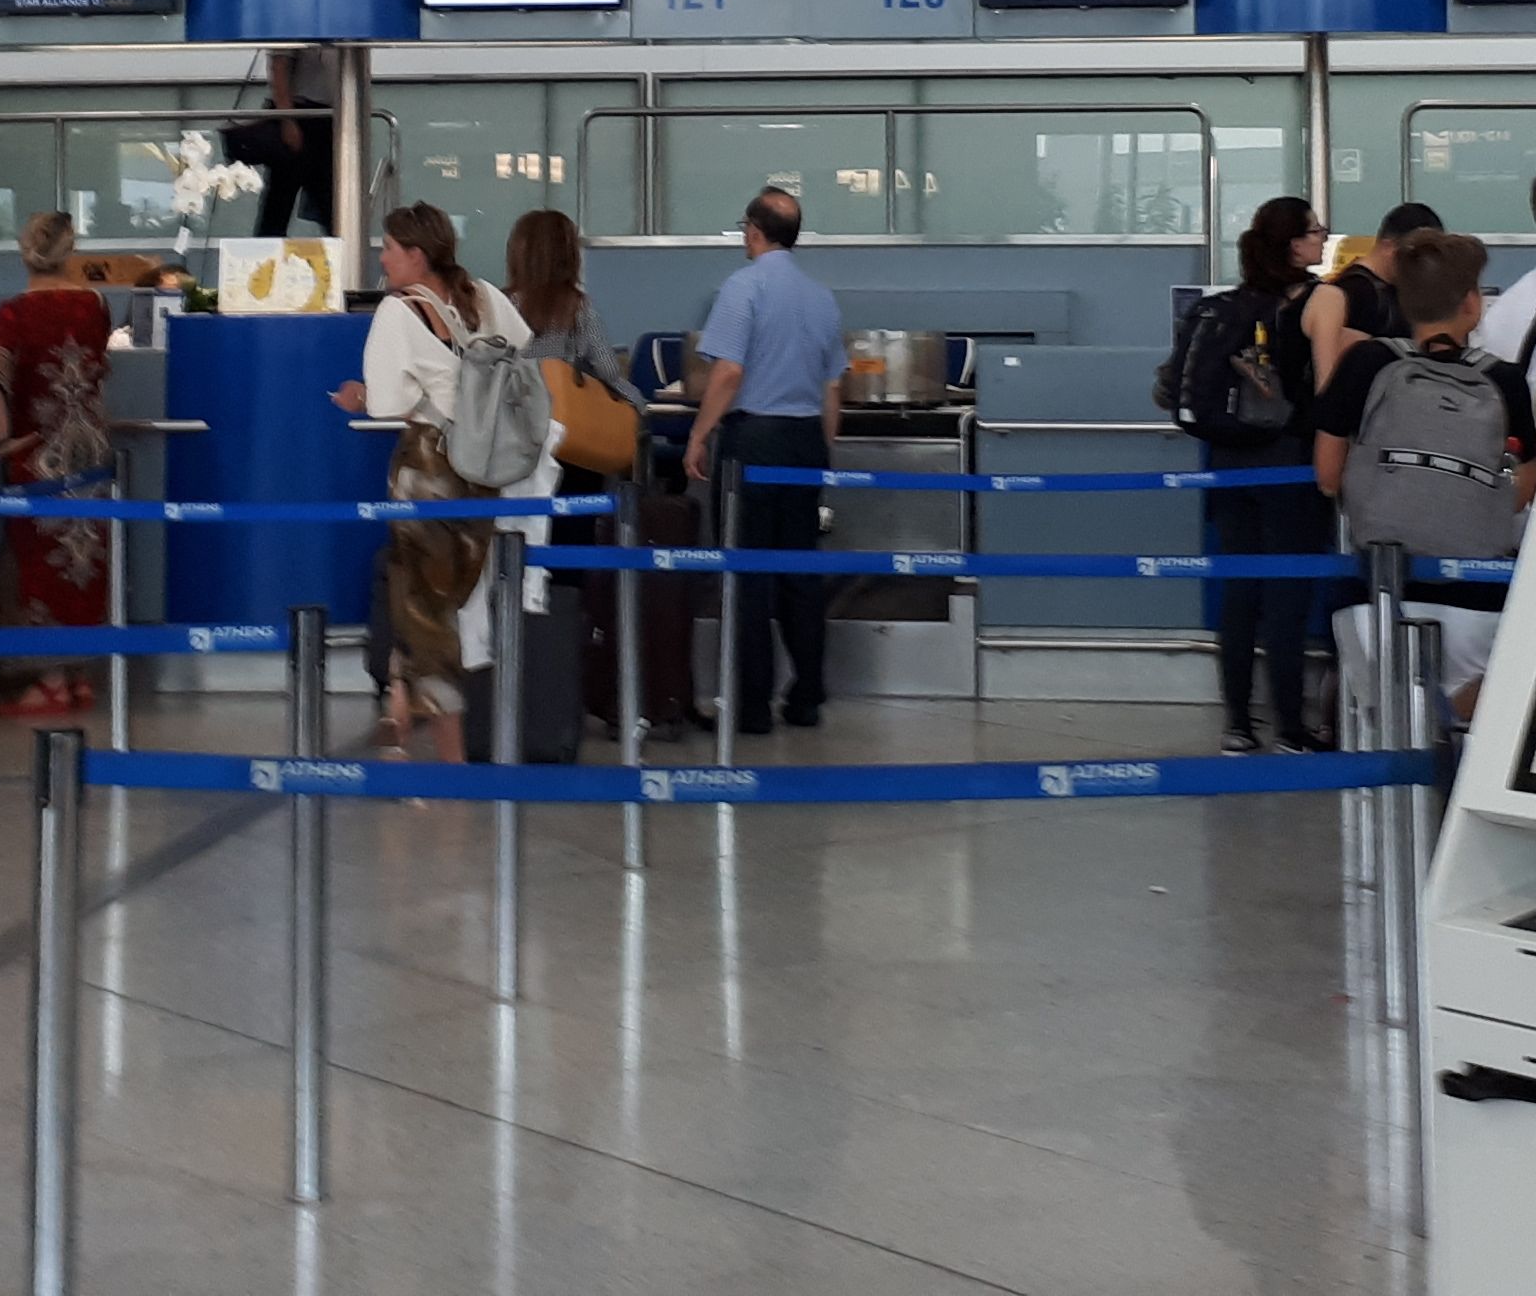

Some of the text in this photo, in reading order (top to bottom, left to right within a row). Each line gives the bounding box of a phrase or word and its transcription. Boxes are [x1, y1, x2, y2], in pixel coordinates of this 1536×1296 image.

[835, 472, 873, 482] ATHENS
[1004, 475, 1042, 486] ATHENS
[1178, 472, 1216, 483] ATHENS
[372, 501, 415, 513] ATHENS
[566, 494, 612, 507] ATHENS
[179, 502, 223, 515] ATHENS
[670, 549, 723, 562] ATHENS
[910, 554, 963, 566] ATHENS
[1155, 556, 1211, 568] ATHENS
[211, 625, 275, 642] ATHENS
[279, 760, 367, 782] ATHENS
[1072, 763, 1158, 780] ATHENS
[669, 770, 758, 786] ATHENS
